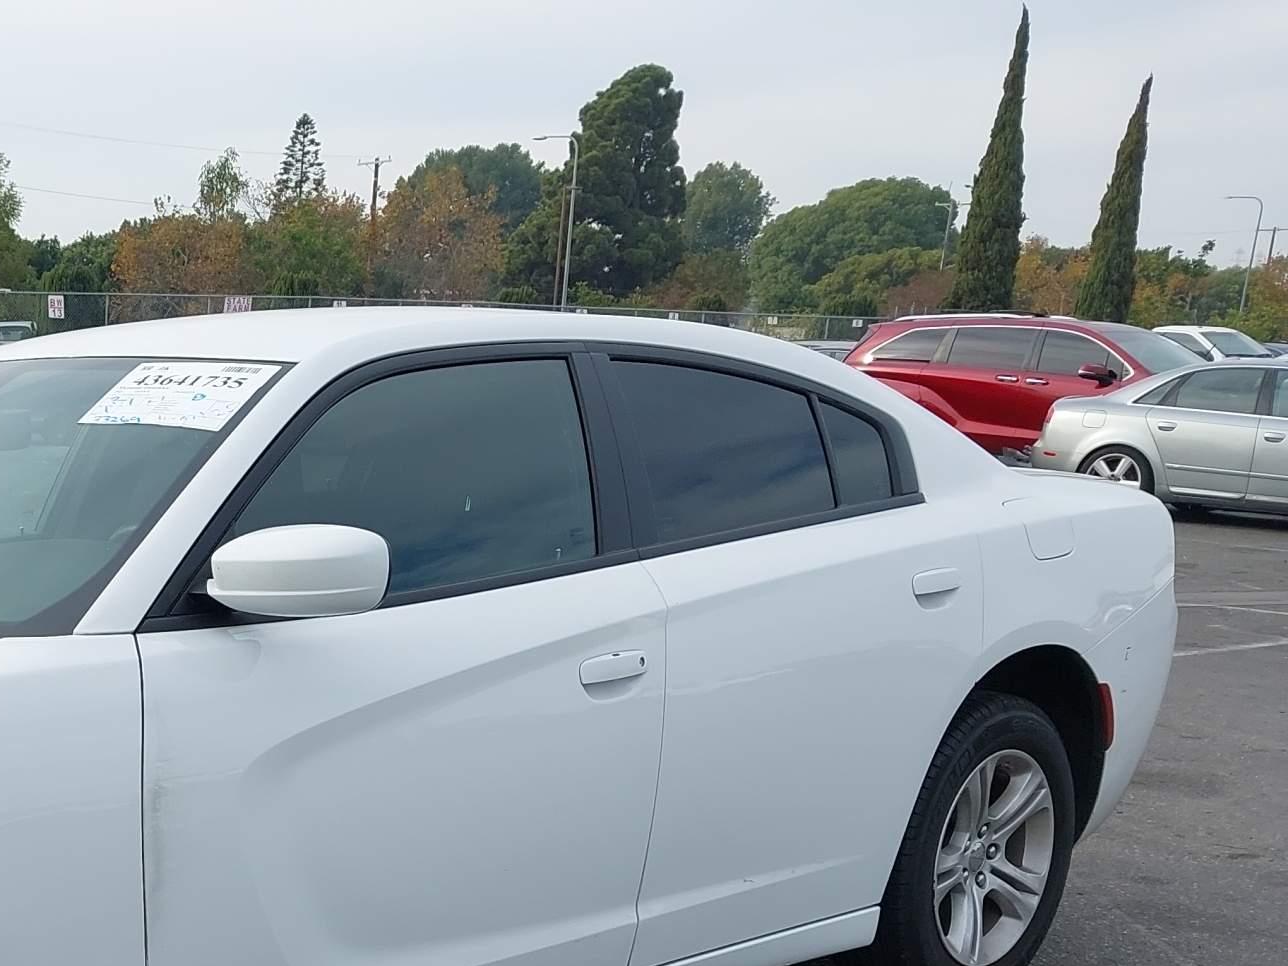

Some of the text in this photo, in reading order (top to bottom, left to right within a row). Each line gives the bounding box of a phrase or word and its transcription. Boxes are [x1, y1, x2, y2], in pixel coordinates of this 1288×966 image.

[49, 298, 63, 307] BW
[51, 309, 63, 318] 13
[133, 374, 249, 389] 43641735
